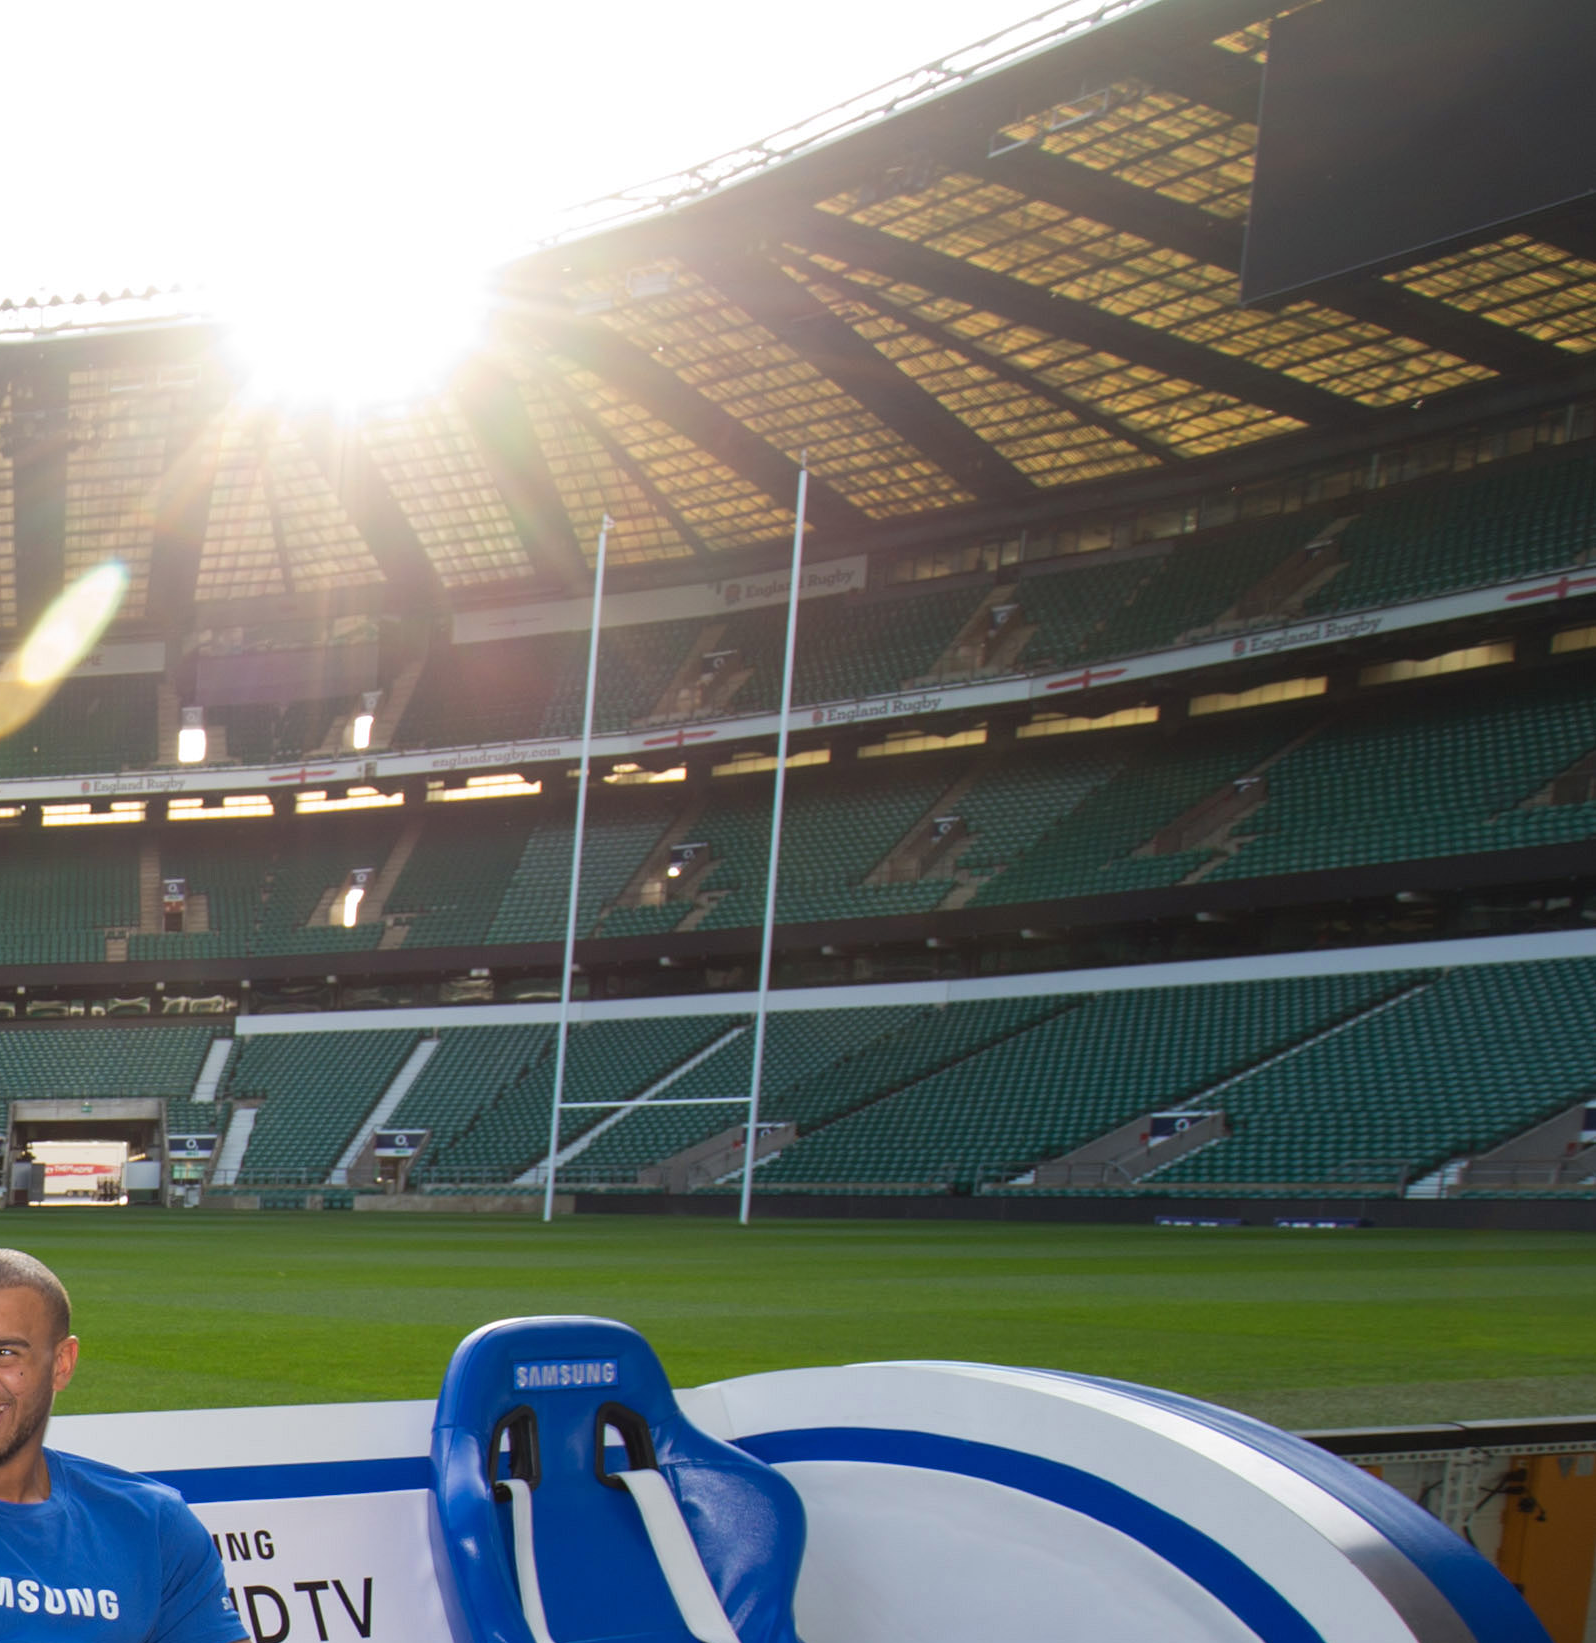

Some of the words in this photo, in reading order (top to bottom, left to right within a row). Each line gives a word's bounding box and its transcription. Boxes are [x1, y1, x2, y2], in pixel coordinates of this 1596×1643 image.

[1249, 629, 1320, 652] England
[1324, 615, 1384, 639] Rugby
[826, 703, 888, 722] England
[892, 695, 942, 714] Rugby
[432, 746, 562, 768] englandrugby.com
[93, 780, 145, 794] England
[146, 777, 185, 792] Rugby
[516, 1362, 615, 1388] SAMSUNG
[293, 1577, 373, 1642] TV
